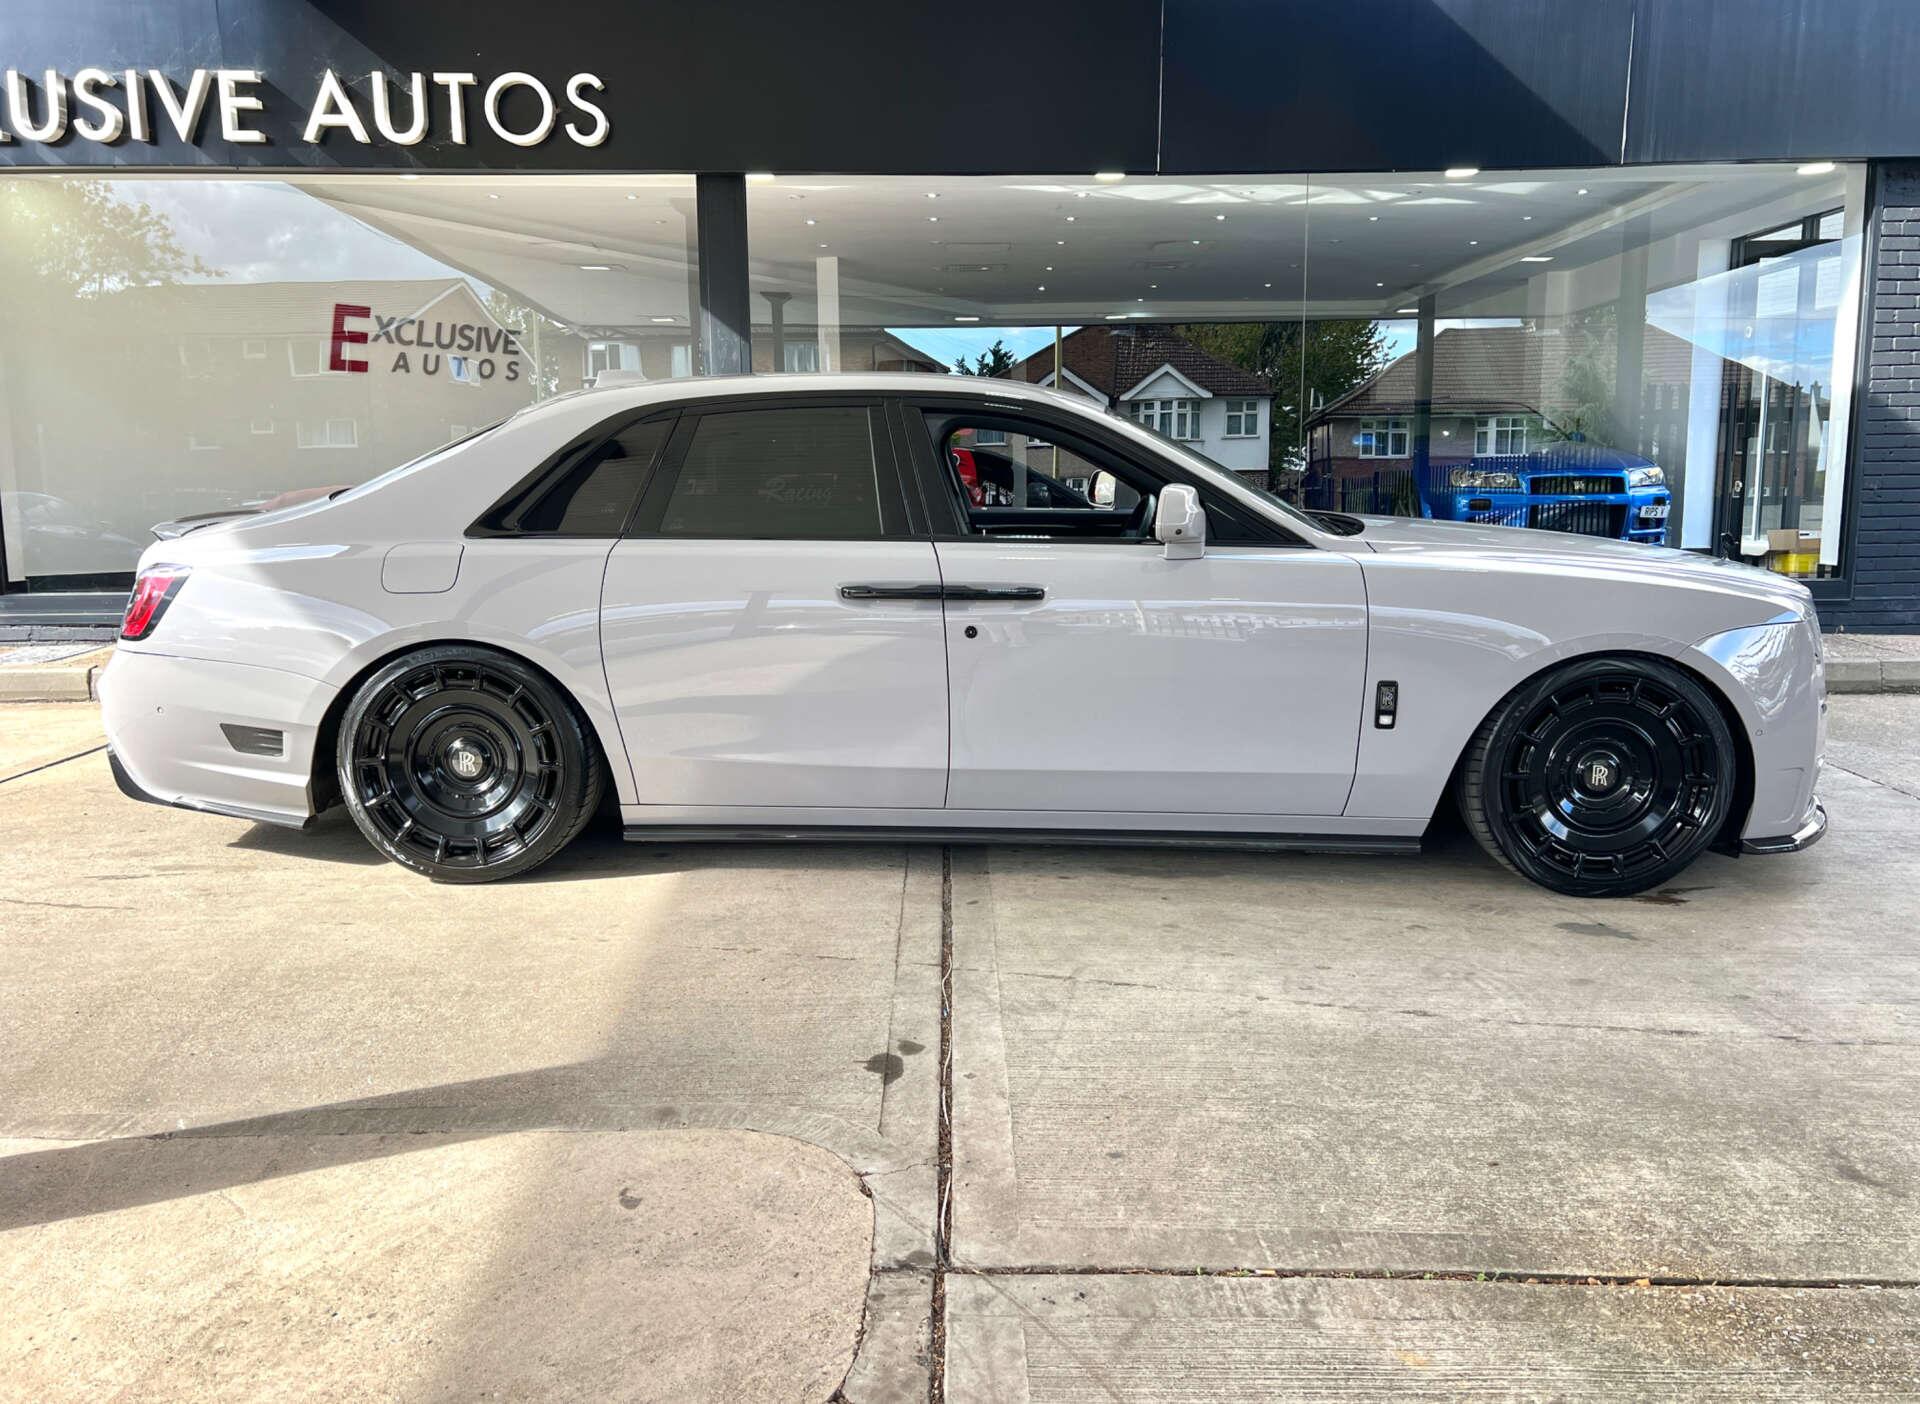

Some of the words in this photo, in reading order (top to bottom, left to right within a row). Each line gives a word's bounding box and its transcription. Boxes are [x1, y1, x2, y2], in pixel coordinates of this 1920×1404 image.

[0, 66, 266, 143] USIVE
[302, 68, 610, 147] AUTOS
[329, 303, 521, 373] EXCLUSIVE
[391, 351, 520, 381] AUTOS
[459, 751, 476, 773] RR
[1591, 764, 1609, 786] RR
